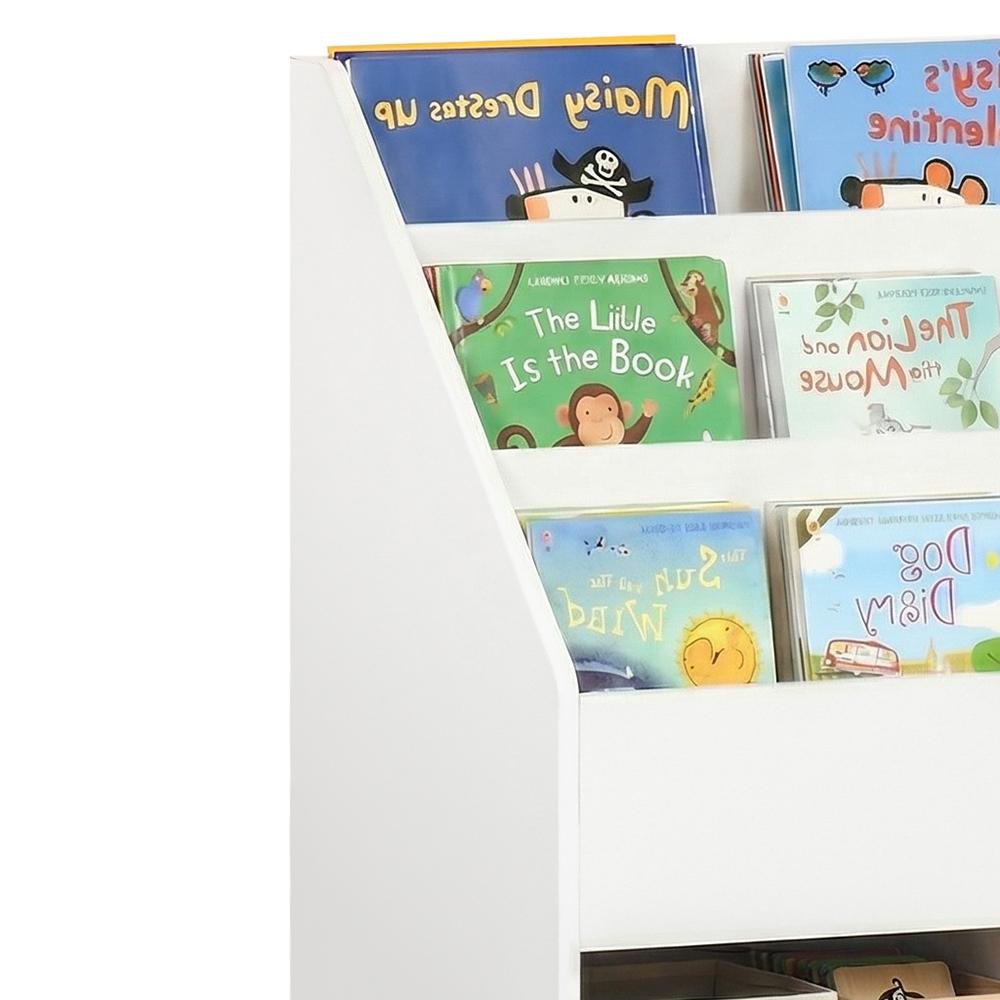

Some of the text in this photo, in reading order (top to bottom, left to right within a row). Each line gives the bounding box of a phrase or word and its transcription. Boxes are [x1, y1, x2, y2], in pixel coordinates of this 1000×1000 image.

[524, 306, 580, 338] The
[500, 338, 695, 393] Is the Book
